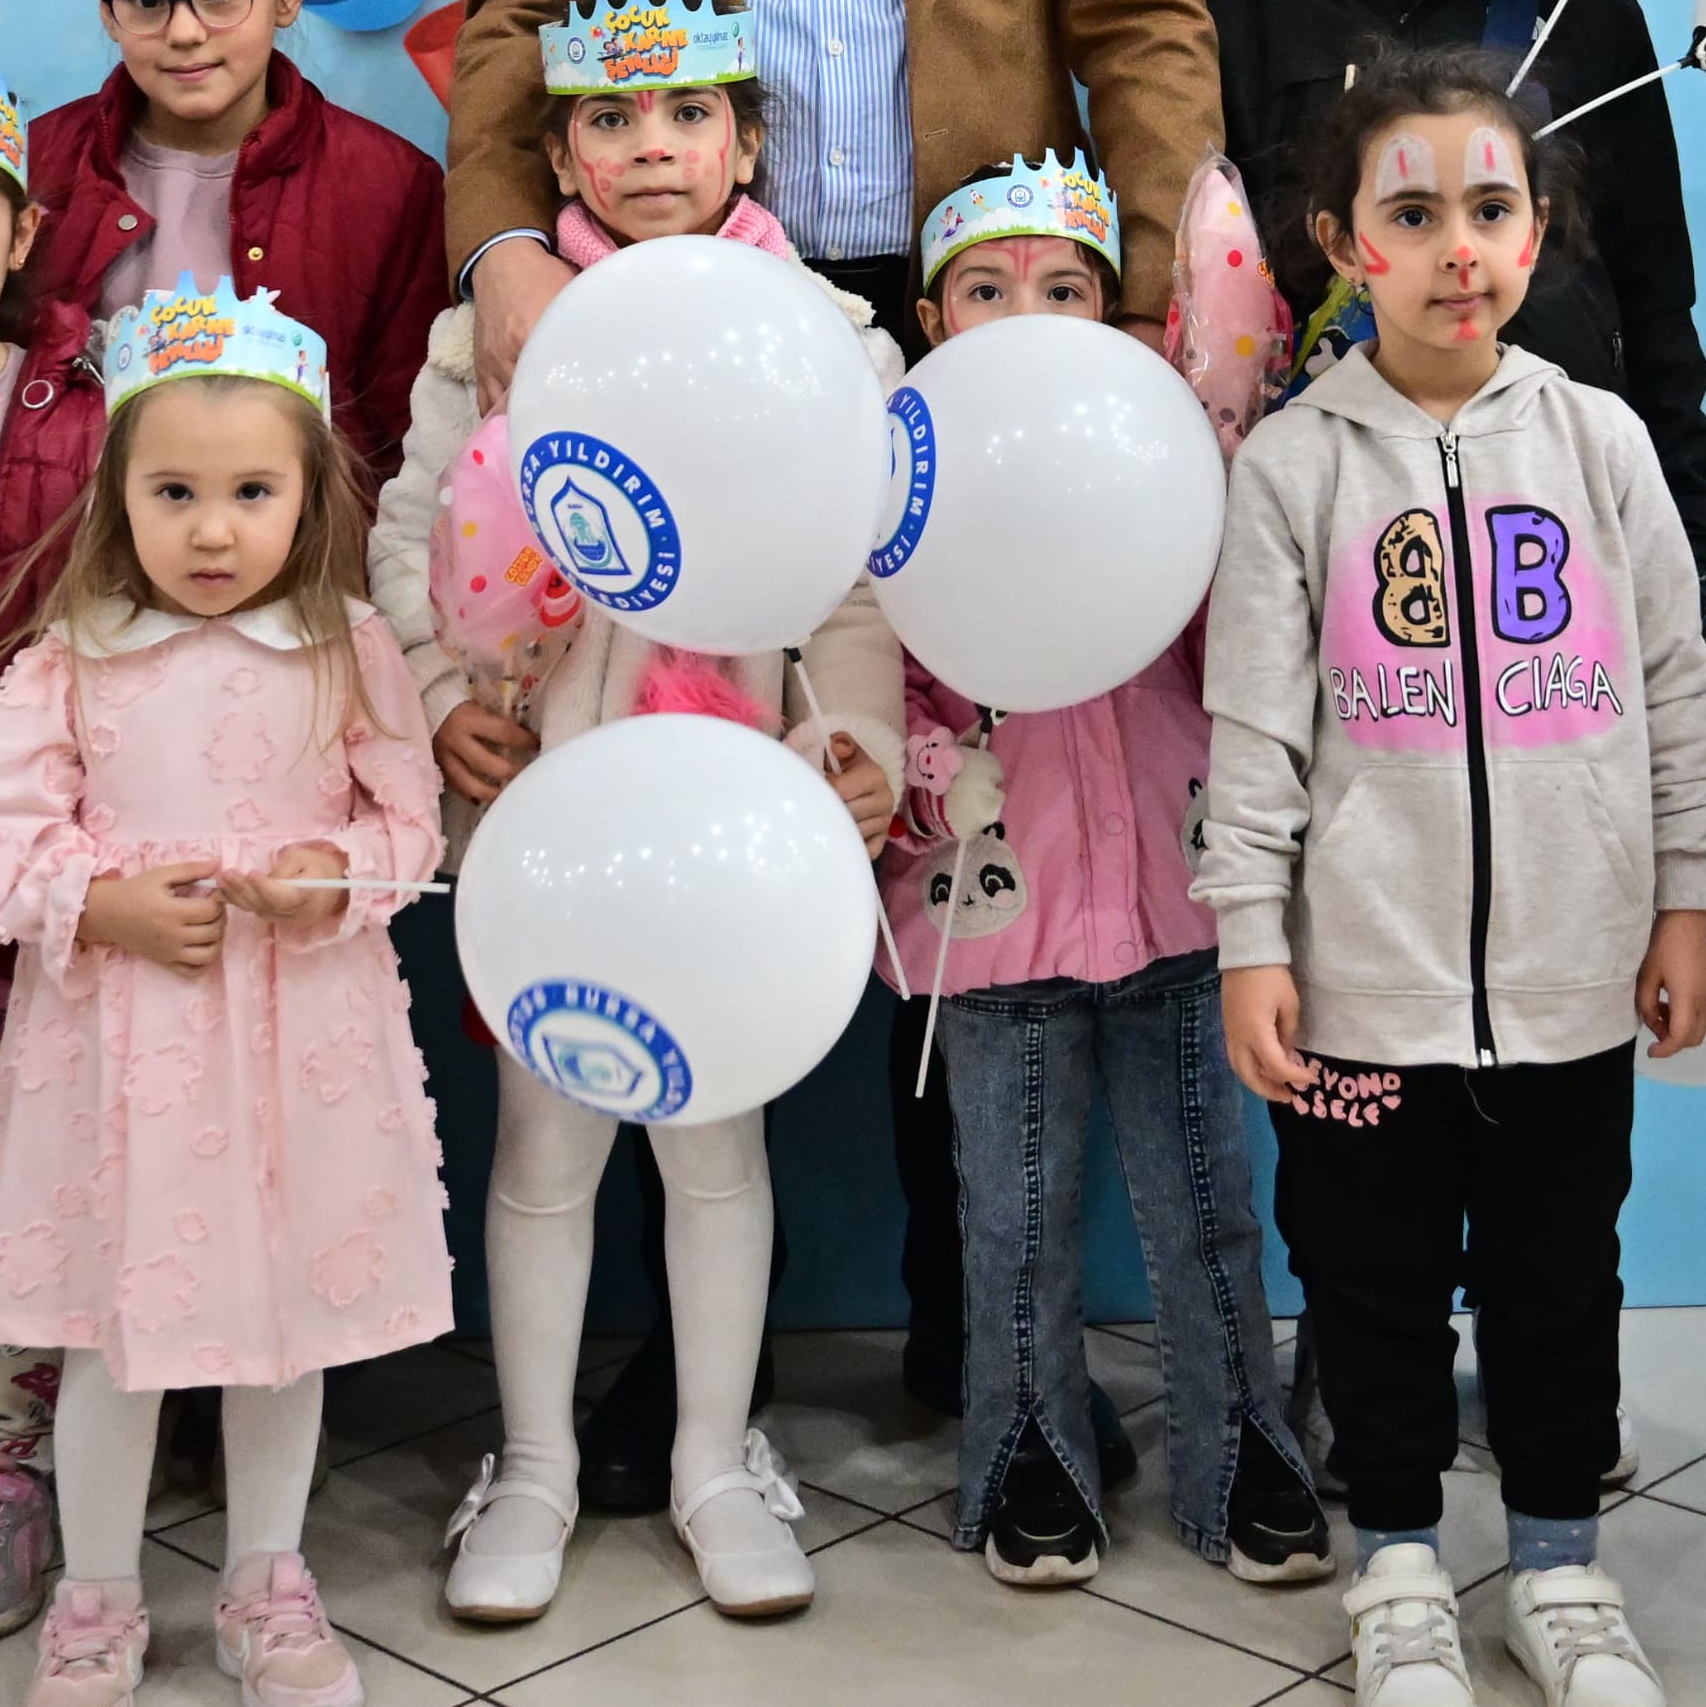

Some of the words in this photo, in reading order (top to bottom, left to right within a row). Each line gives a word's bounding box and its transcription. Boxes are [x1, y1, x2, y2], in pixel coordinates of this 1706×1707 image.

[604, 4, 671, 35] ÇOCUK
[621, 27, 690, 53] KARNE
[548, 439, 667, 530] YILDIRIM
[898, 393, 930, 516] YILDIRIM
[1485, 504, 1574, 644] B
[1329, 658, 1457, 728] BALEN
[1495, 652, 1626, 718] CIAGA
